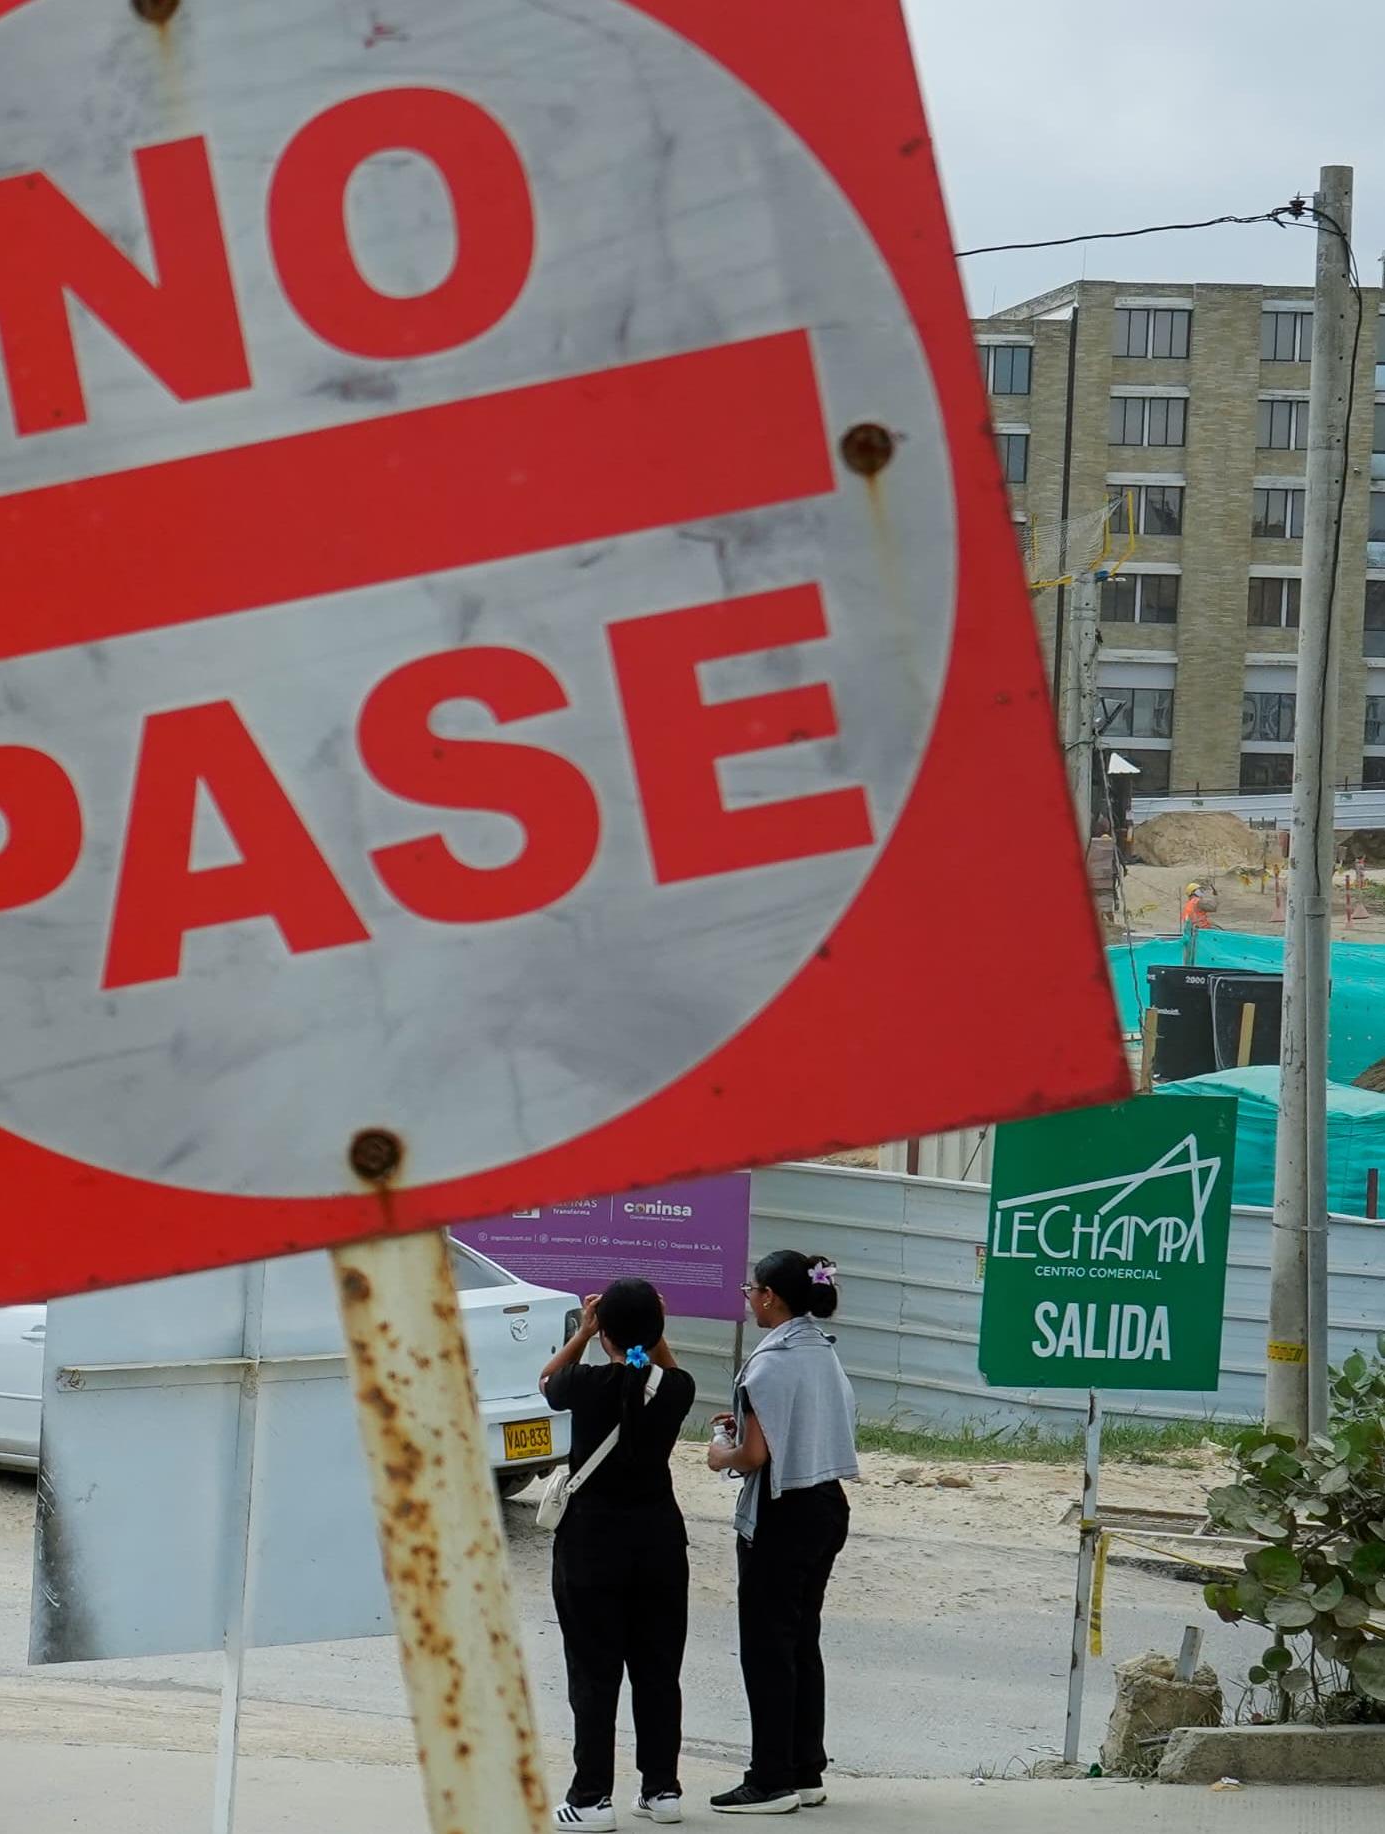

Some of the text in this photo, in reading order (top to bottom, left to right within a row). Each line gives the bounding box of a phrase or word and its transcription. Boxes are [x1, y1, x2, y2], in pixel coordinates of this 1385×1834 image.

[623, 1200, 693, 1217] coninsa
[1034, 1266, 1162, 1280] CENTRO COMERCIAL
[1032, 1301, 1171, 1361] SALIDA
